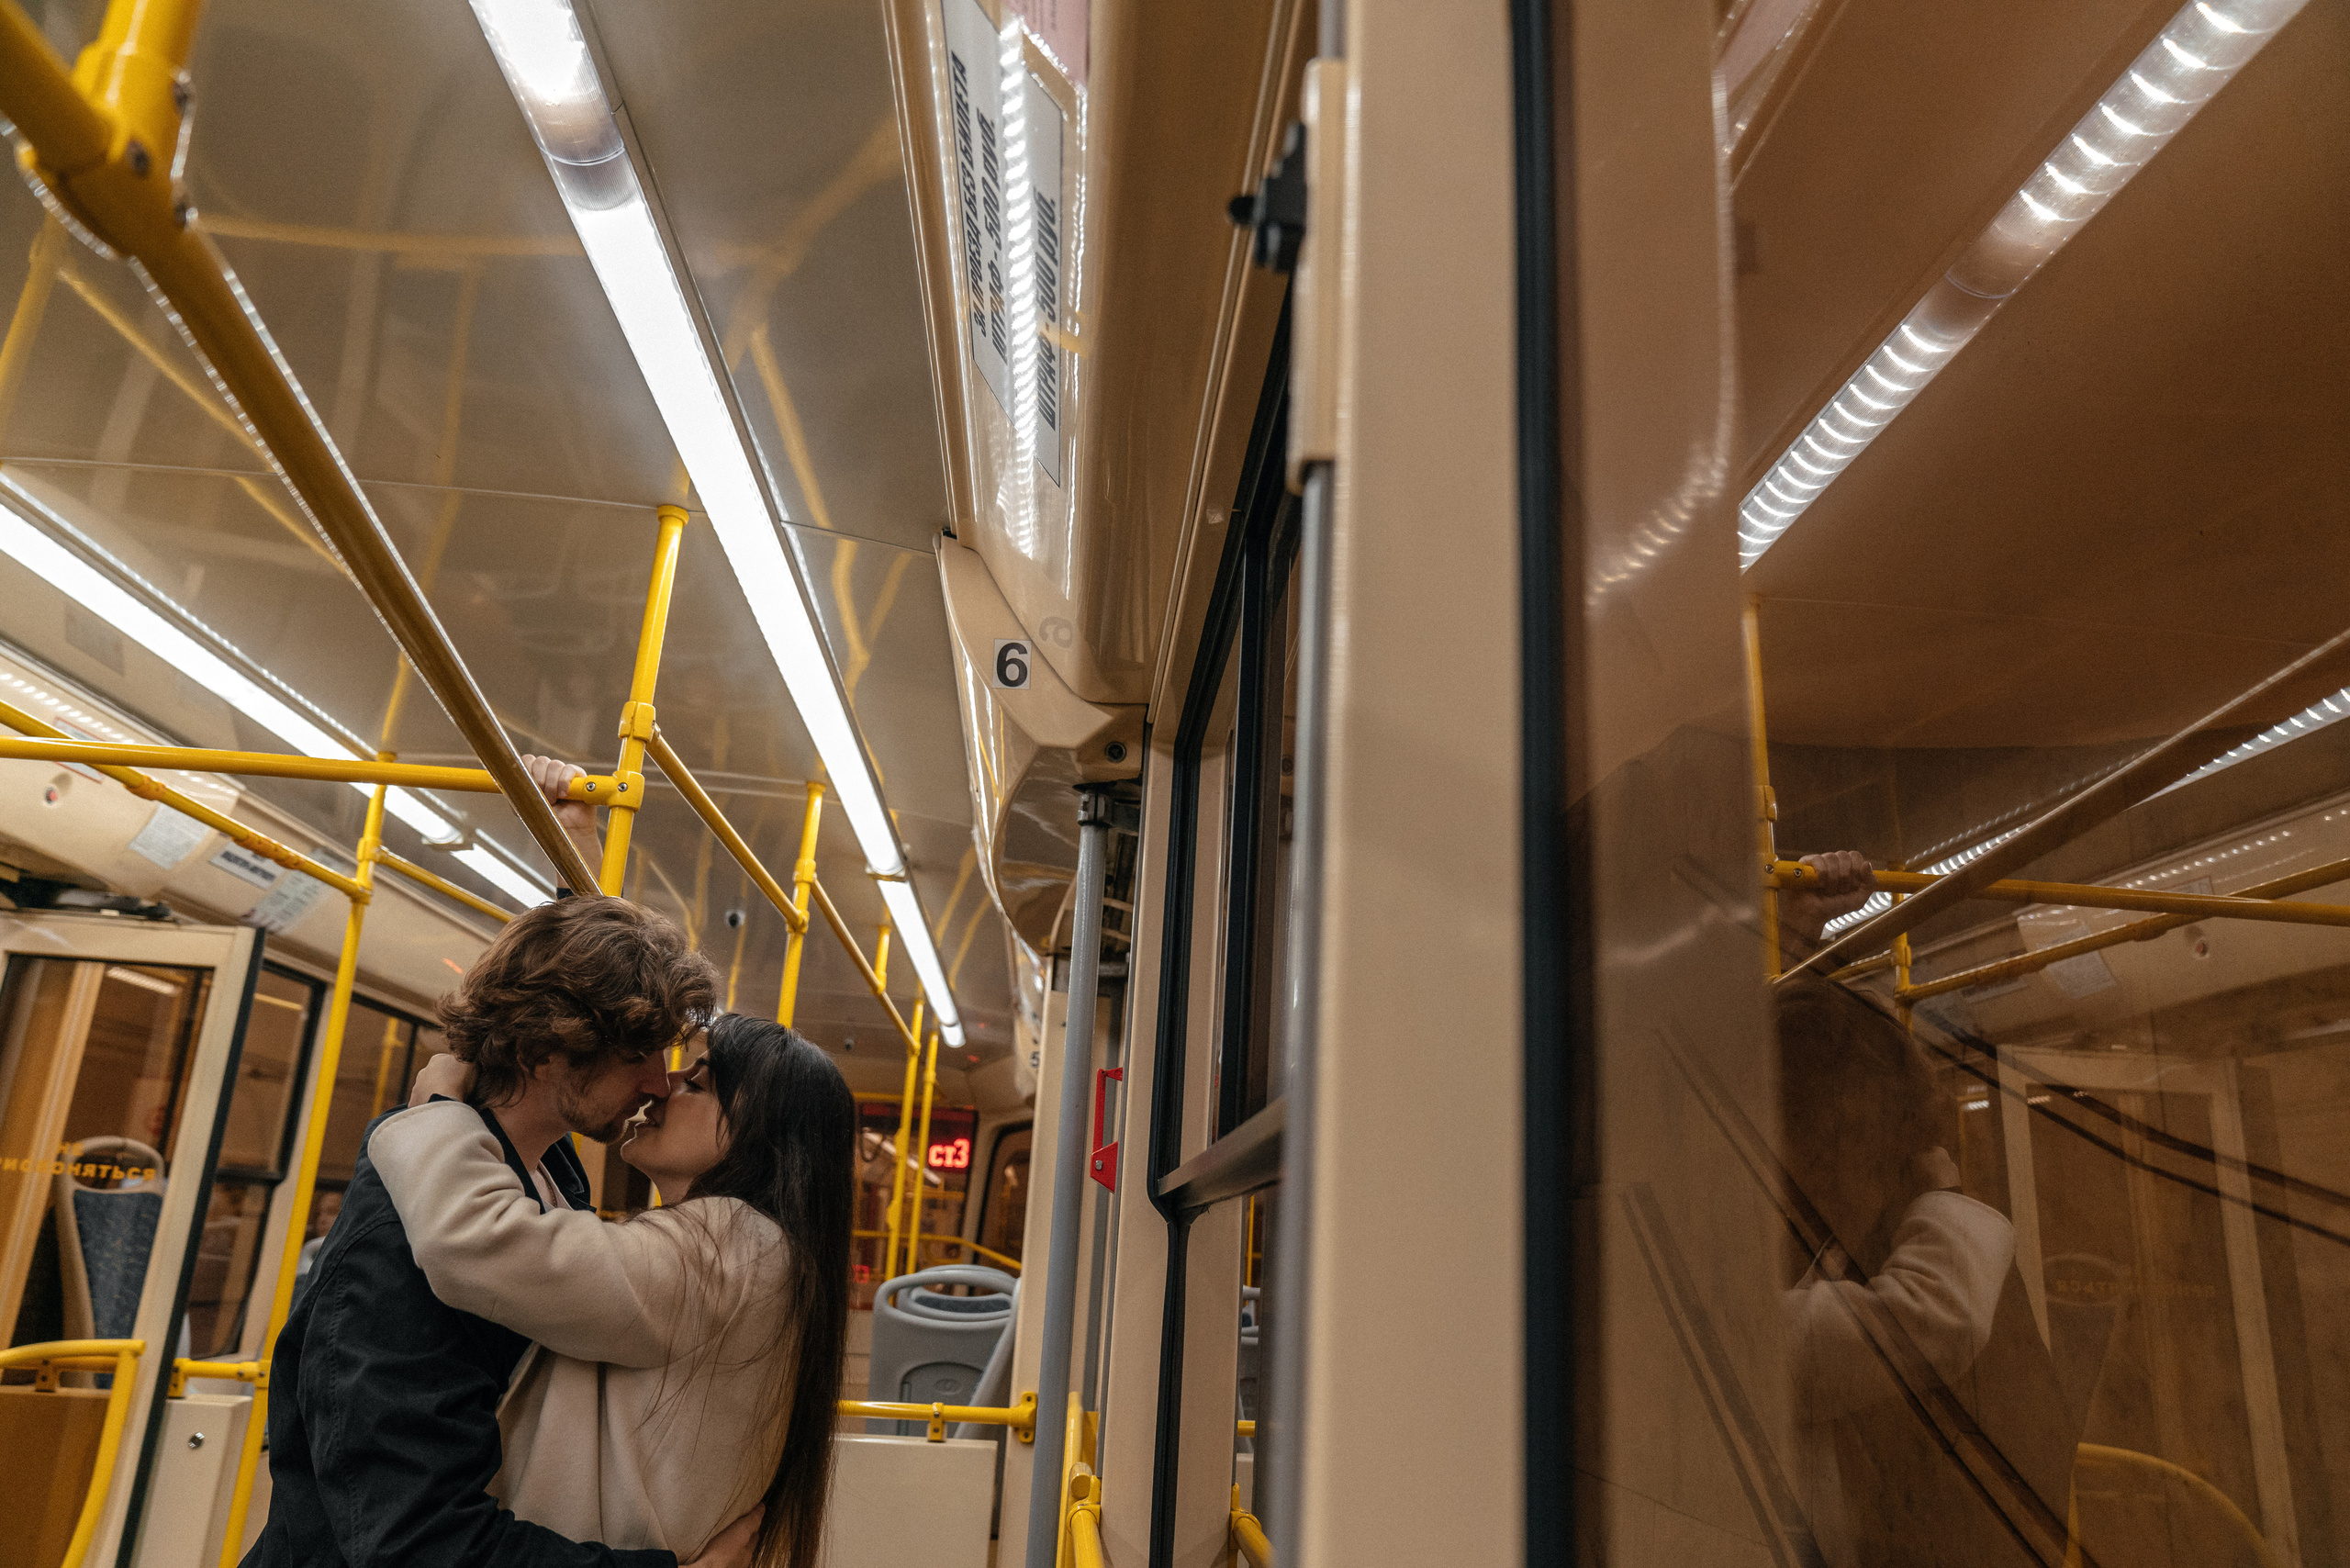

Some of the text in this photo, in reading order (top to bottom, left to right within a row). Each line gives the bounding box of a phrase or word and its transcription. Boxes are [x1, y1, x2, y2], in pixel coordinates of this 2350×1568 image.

[976, 107, 1001, 192] руб.
[950, 50, 987, 338] ЗА ПРОЕЗД БЕЗ БИЛЕТА
[981, 176, 1002, 252] 500
[1033, 185, 1058, 267] руб.
[988, 260, 1008, 365] ШТРАФ
[1035, 252, 1057, 323] 500
[1037, 331, 1057, 431] ШТРАФ
[996, 642, 1028, 688] 6
[0, 1157, 156, 1182] ИСЛОНЯТЬСЯ
